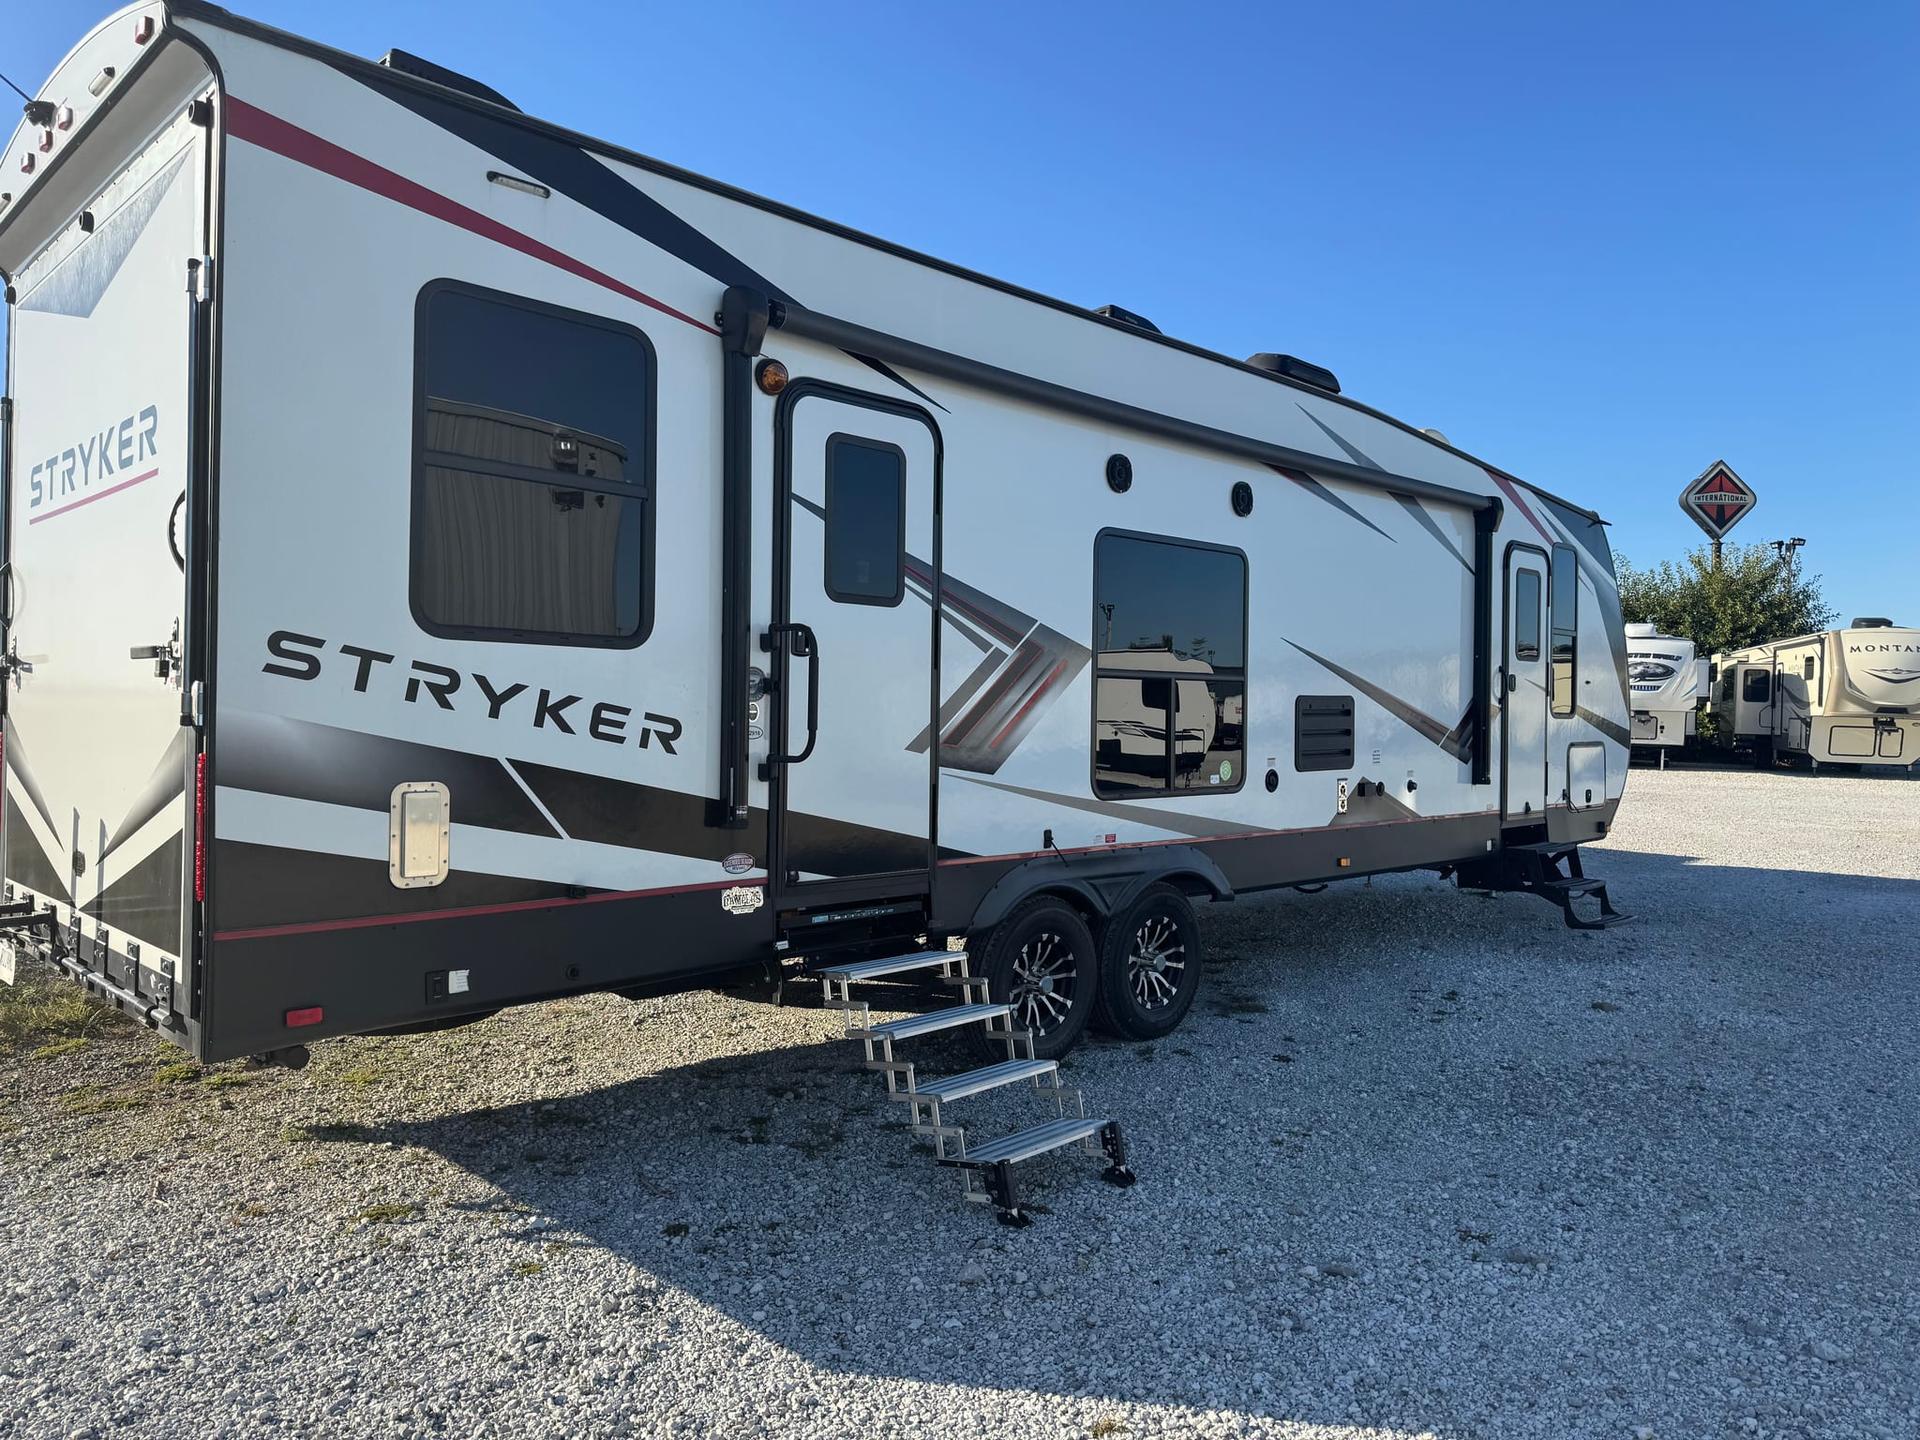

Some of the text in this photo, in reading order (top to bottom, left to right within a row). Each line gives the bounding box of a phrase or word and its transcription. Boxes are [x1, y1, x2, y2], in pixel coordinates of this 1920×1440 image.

[30, 404, 158, 508] STRYKER
[1694, 493, 1748, 502] INTERNATIONAL
[261, 630, 683, 756] STRYKER
